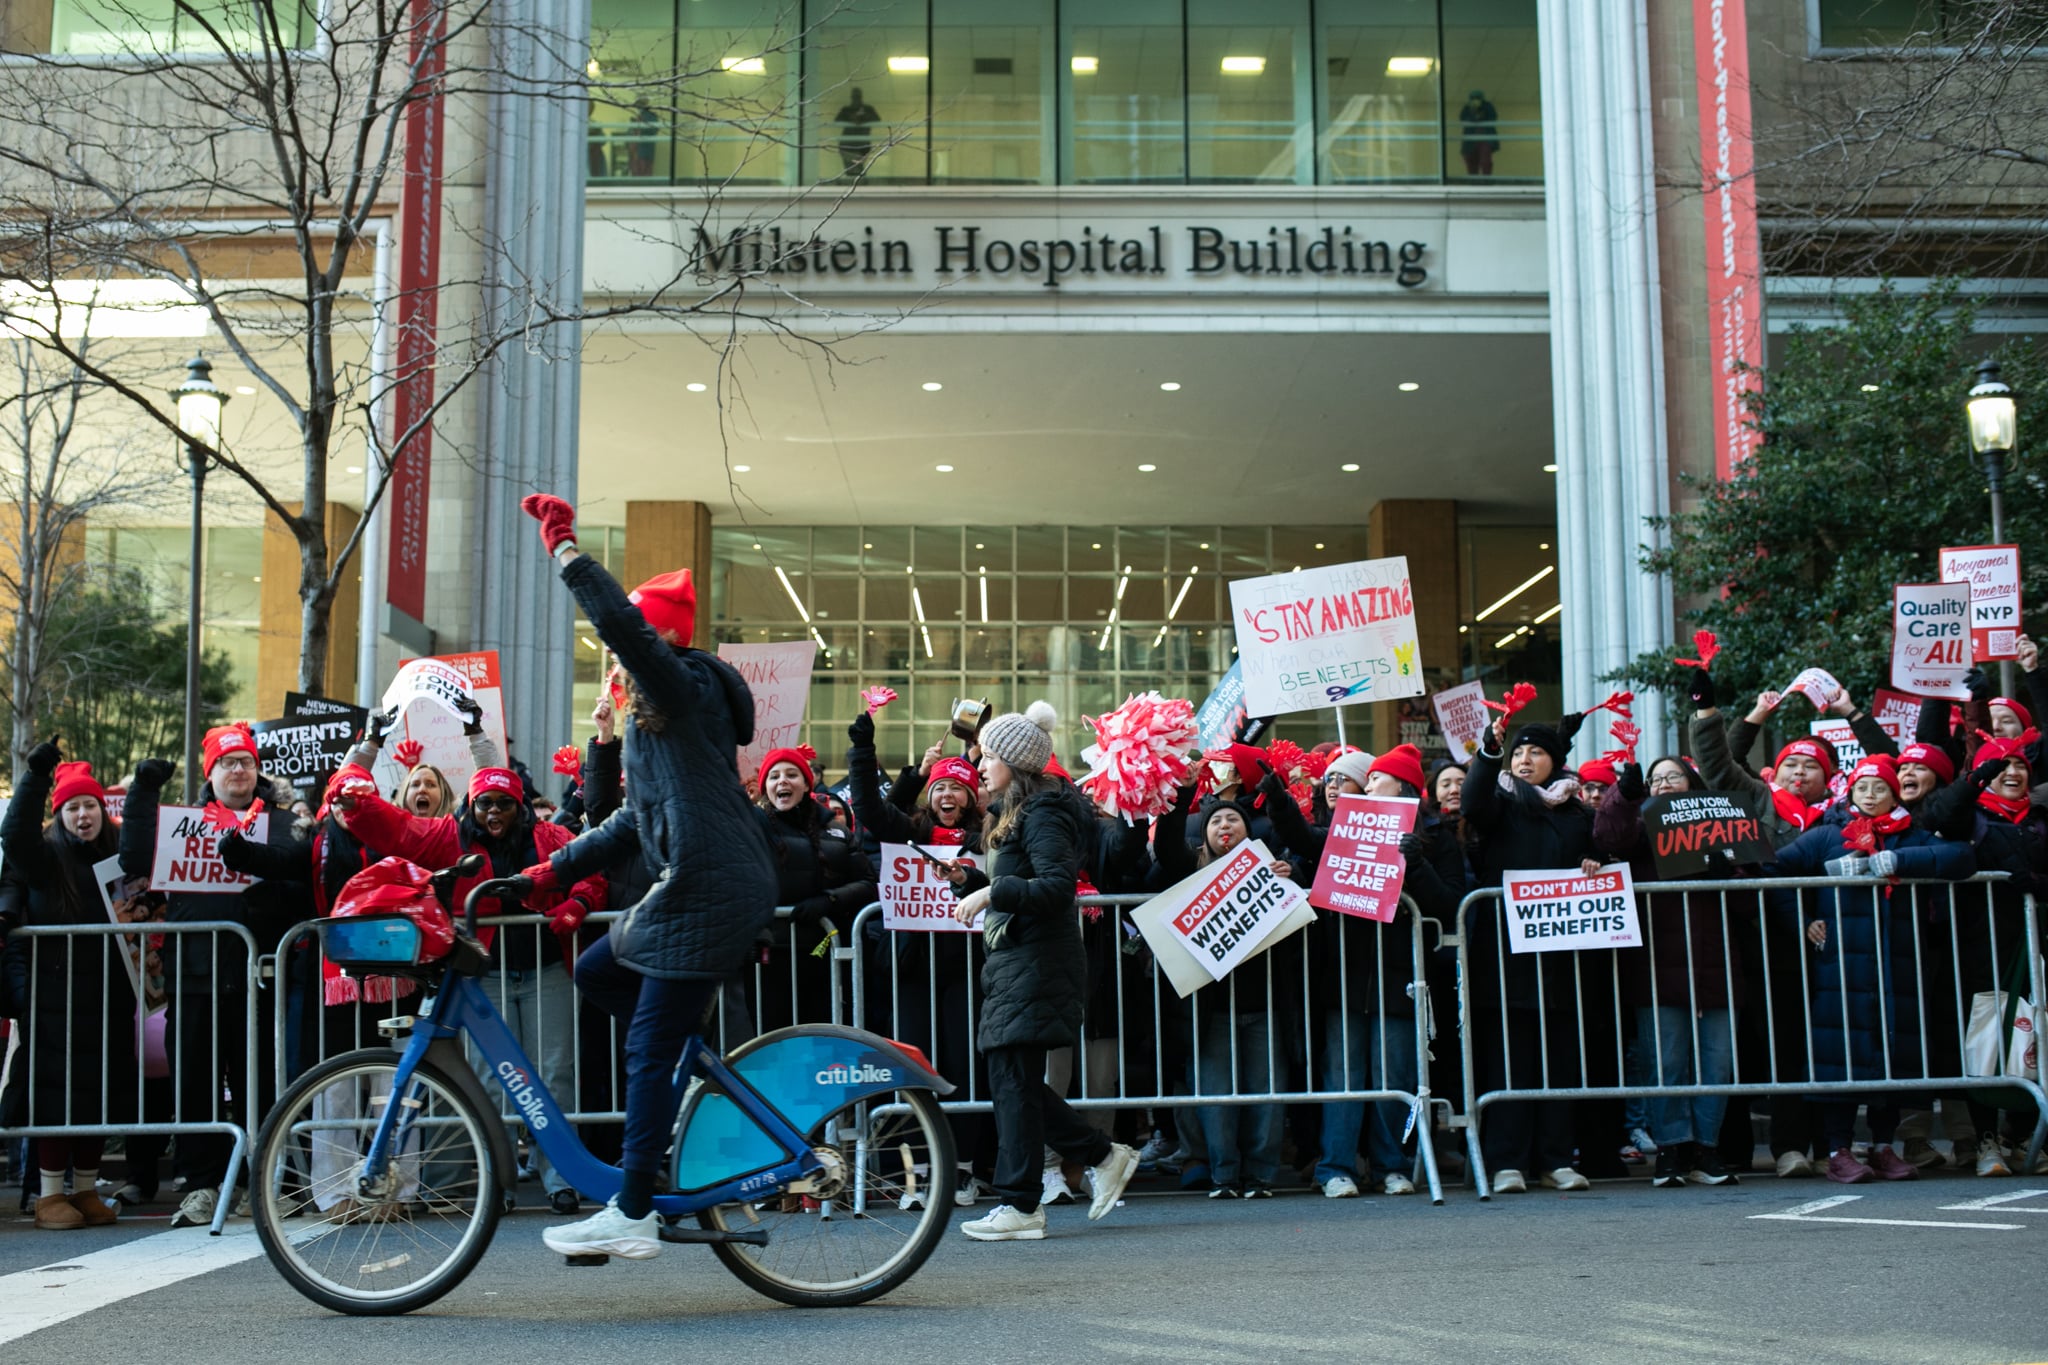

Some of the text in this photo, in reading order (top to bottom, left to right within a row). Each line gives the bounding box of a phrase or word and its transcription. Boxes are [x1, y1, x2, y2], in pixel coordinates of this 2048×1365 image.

[690, 226, 1428, 288] Milstein Hospital Building
[400, 483, 414, 573] Center
[1946, 554, 2009, 577] Apoyamos
[1329, 567, 1378, 593] HARD
[1377, 563, 1404, 584] TO
[1900, 598, 1967, 616] Quality
[1976, 606, 2013, 621] NYP
[1908, 620, 1961, 637] Care
[1904, 643, 1926, 656] for
[1924, 640, 1963, 664] All
[1279, 657, 1392, 691] BENEFITS
[306, 699, 327, 711] NEW
[1201, 675, 1239, 725] NEW YORK
[1273, 691, 1323, 712] ARE
[1441, 692, 1479, 712] HOSPITAL
[1444, 710, 1484, 730] LITERALLY
[1450, 725, 1471, 738] MAKE
[256, 721, 351, 749] PATIENTS
[276, 741, 322, 759] OVER
[261, 752, 345, 776] PROFITS
[1670, 797, 1731, 811] NEW YORK
[1347, 810, 1401, 829] MORE
[1661, 807, 1746, 825] PRESBYTERIAN
[1657, 818, 1759, 856] UNFAIR!
[1326, 854, 1399, 879] BETTER
[1181, 855, 1253, 929] DON'T MESS
[1333, 870, 1386, 892] CARE
[1519, 876, 1616, 897] DON'T MESS
[1190, 900, 1238, 949] WITH
[1236, 866, 1274, 904] OUR
[1516, 896, 1626, 920] WITH OUR
[1209, 882, 1285, 962] BENEFITS
[1524, 915, 1625, 939] BENEFITS
[815, 1064, 893, 1085] citi bike
[498, 1061, 548, 1130] citi bike
